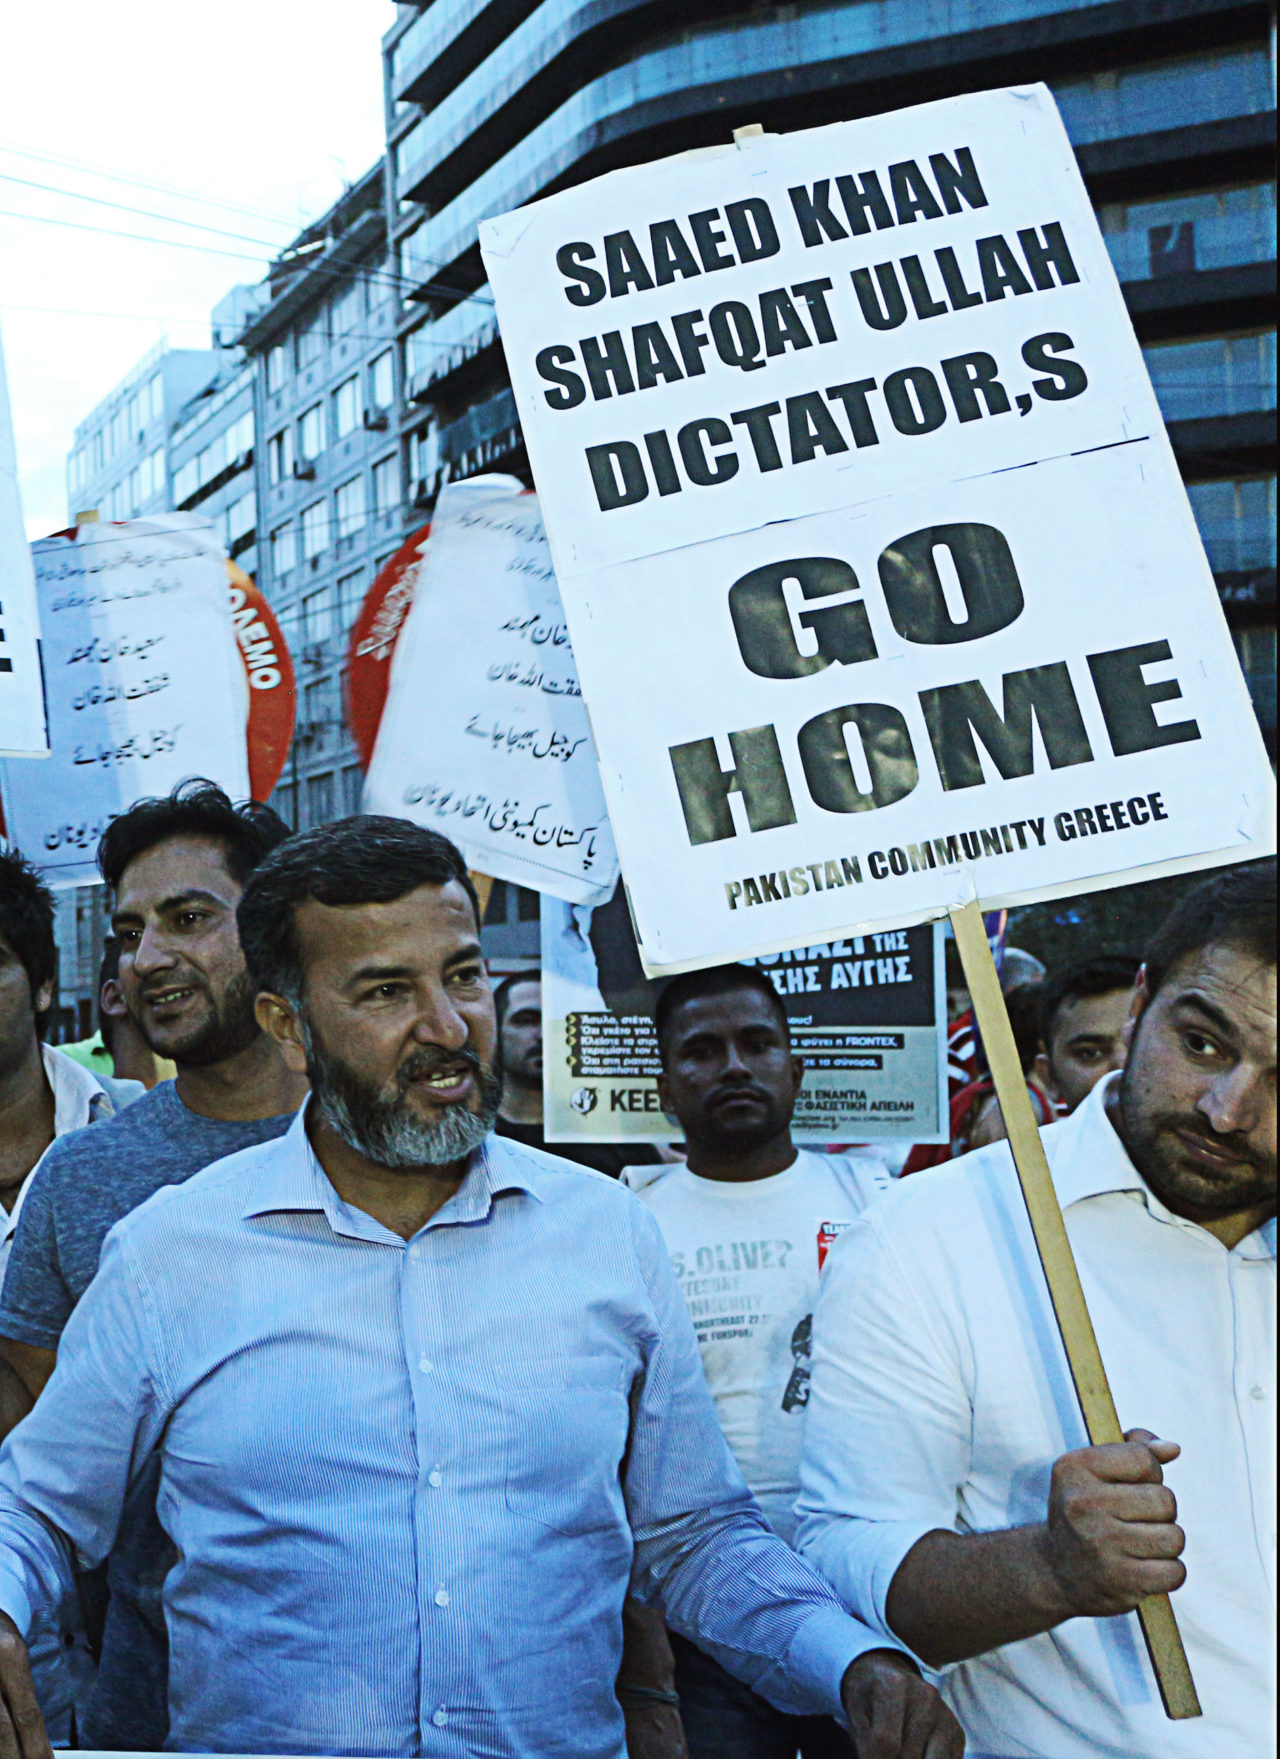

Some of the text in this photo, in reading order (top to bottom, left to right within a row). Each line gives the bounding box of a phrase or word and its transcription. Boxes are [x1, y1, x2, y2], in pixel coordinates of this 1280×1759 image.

[556, 146, 989, 307] SAAED KHAN
[535, 220, 1081, 411] SHAFQAT ULLAH
[584, 331, 1088, 512] DICTATOR,S
[728, 521, 1025, 680] GO
[669, 639, 1202, 847] HOME
[723, 791, 1169, 911] PAKISTAN COMMUNITY GREECE
[763, 955, 913, 996] ΣΗΣ ΑΥΓΗΣ
[872, 931, 910, 953] ΤΗΣ
